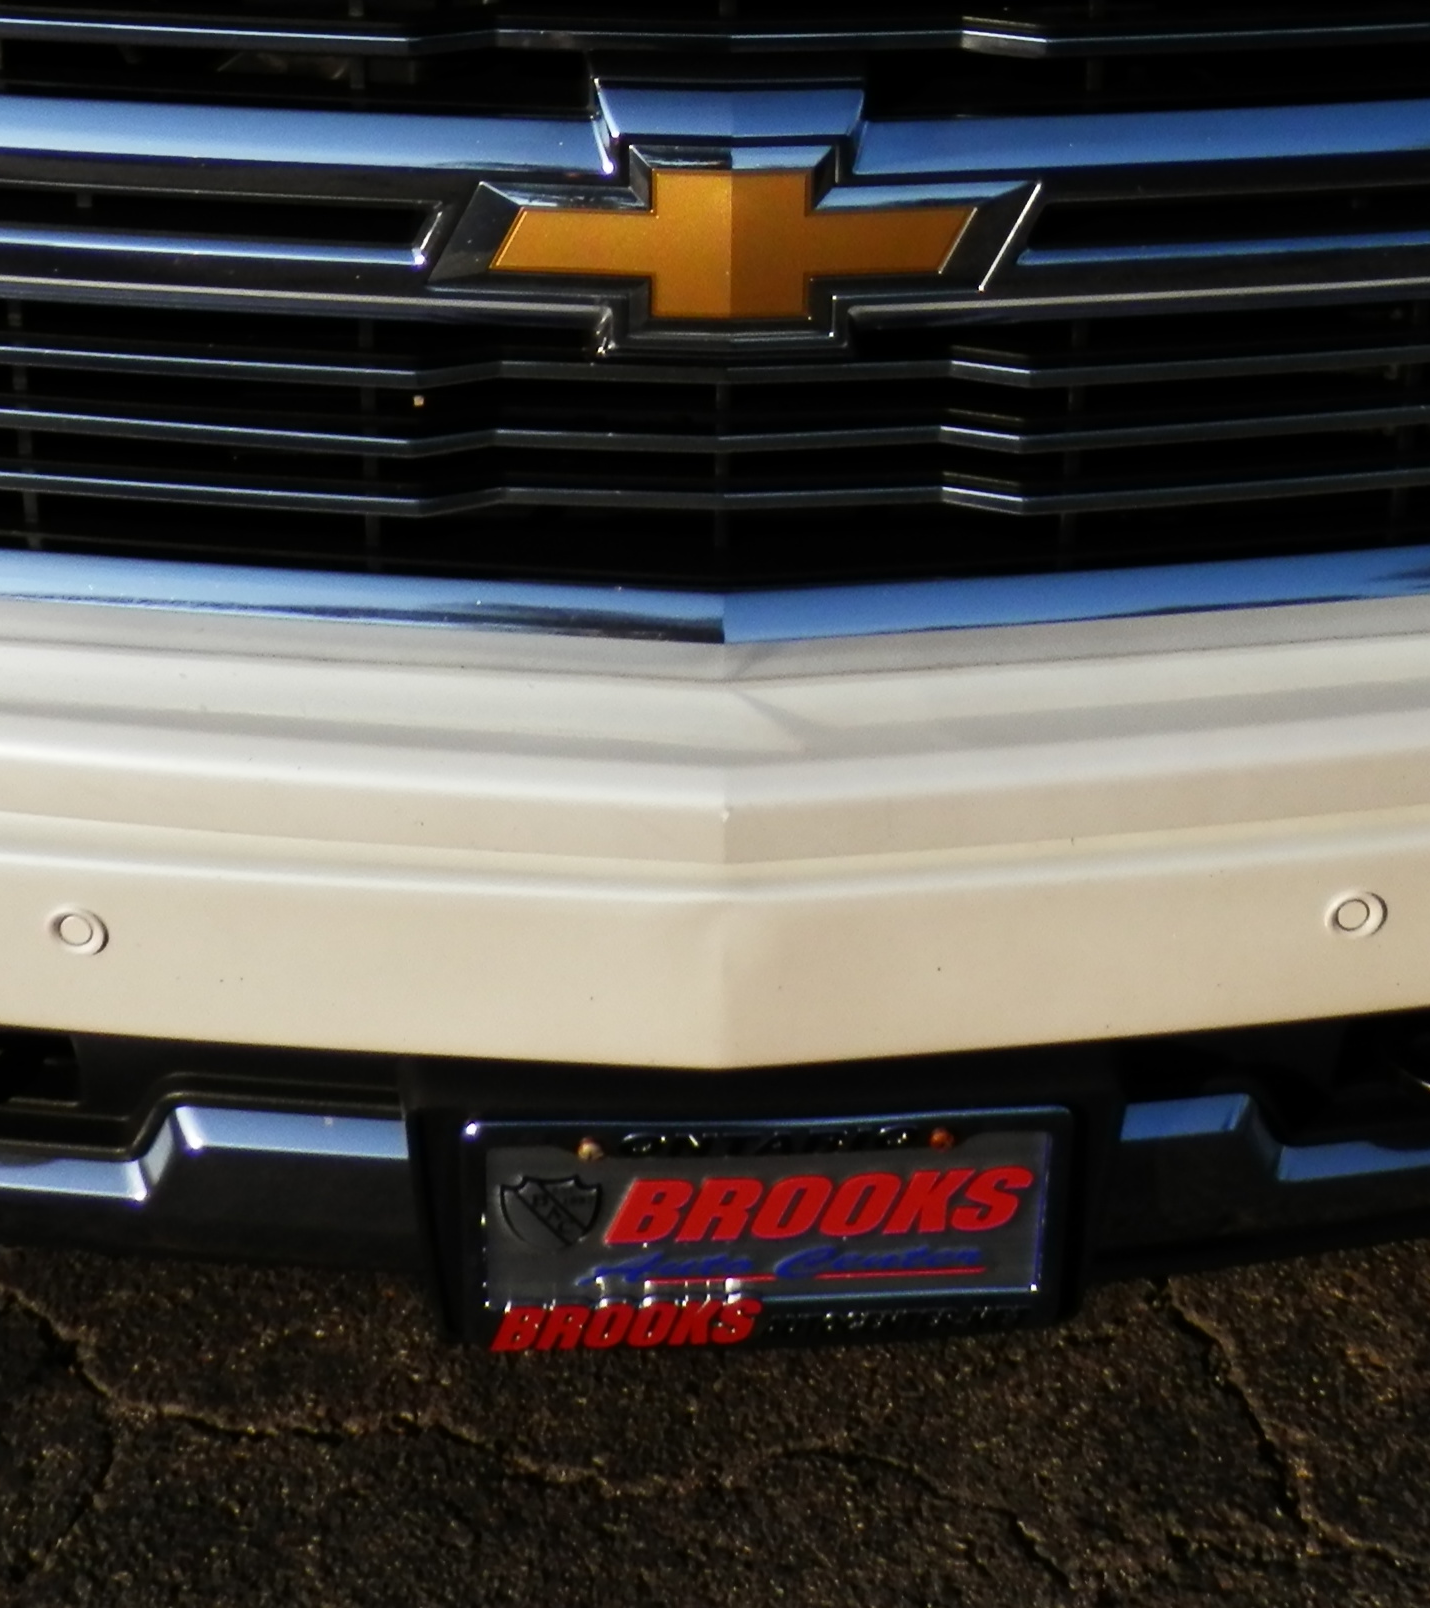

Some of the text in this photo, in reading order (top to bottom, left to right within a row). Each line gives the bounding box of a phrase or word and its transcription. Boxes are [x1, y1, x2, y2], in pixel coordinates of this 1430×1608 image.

[619, 1125, 919, 1159] ONTARIO
[603, 1166, 1036, 1246] BROOKS
[578, 1246, 984, 1286] Auto Center
[490, 1297, 766, 1352] BROOKS
